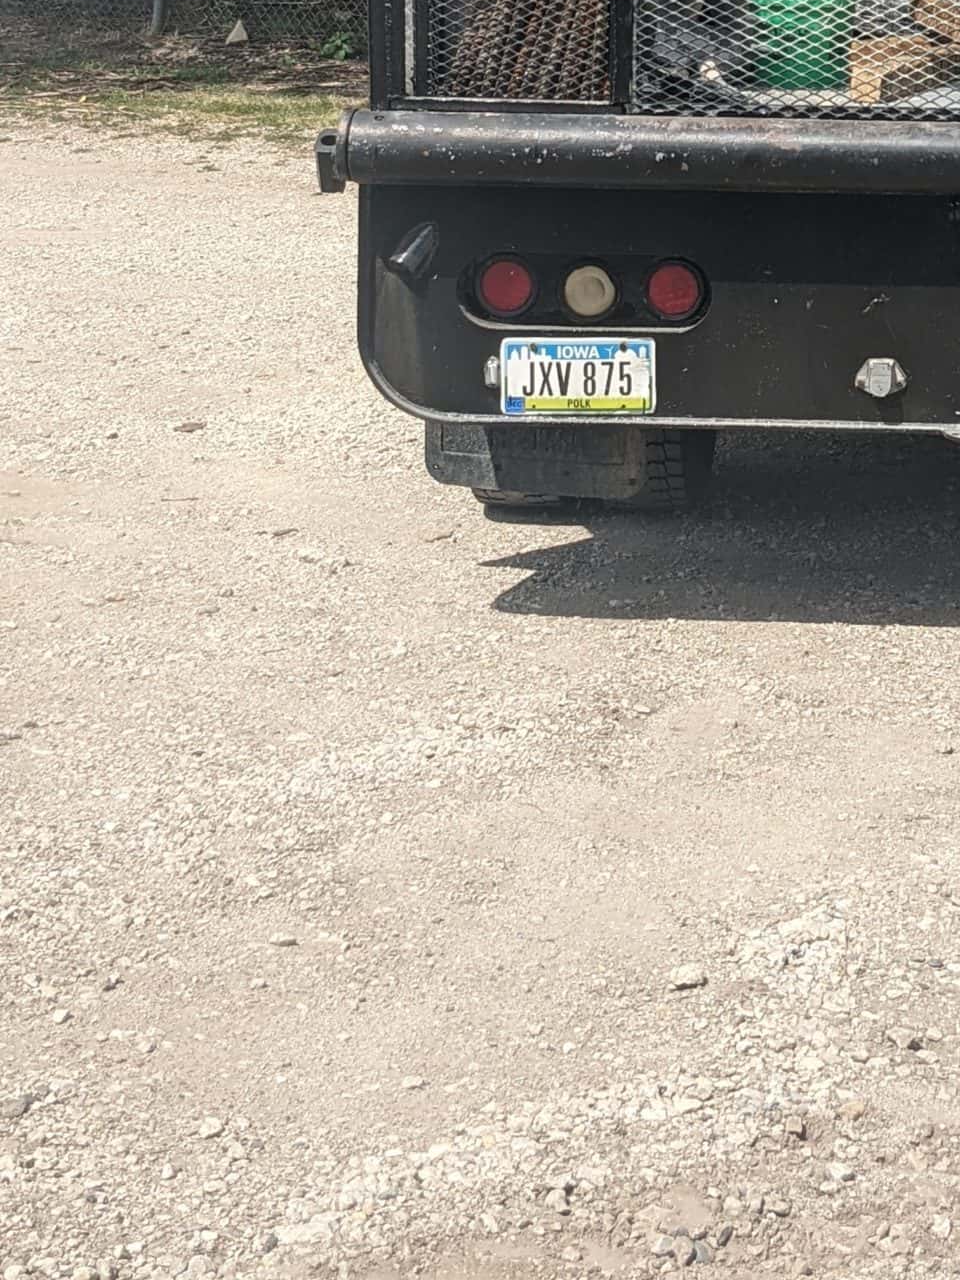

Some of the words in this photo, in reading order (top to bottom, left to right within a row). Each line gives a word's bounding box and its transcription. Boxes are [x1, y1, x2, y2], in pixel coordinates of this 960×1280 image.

[557, 345, 600, 359] IOWA
[522, 362, 571, 396] JXV
[583, 362, 632, 396] 875
[567, 399, 591, 408] POLK
